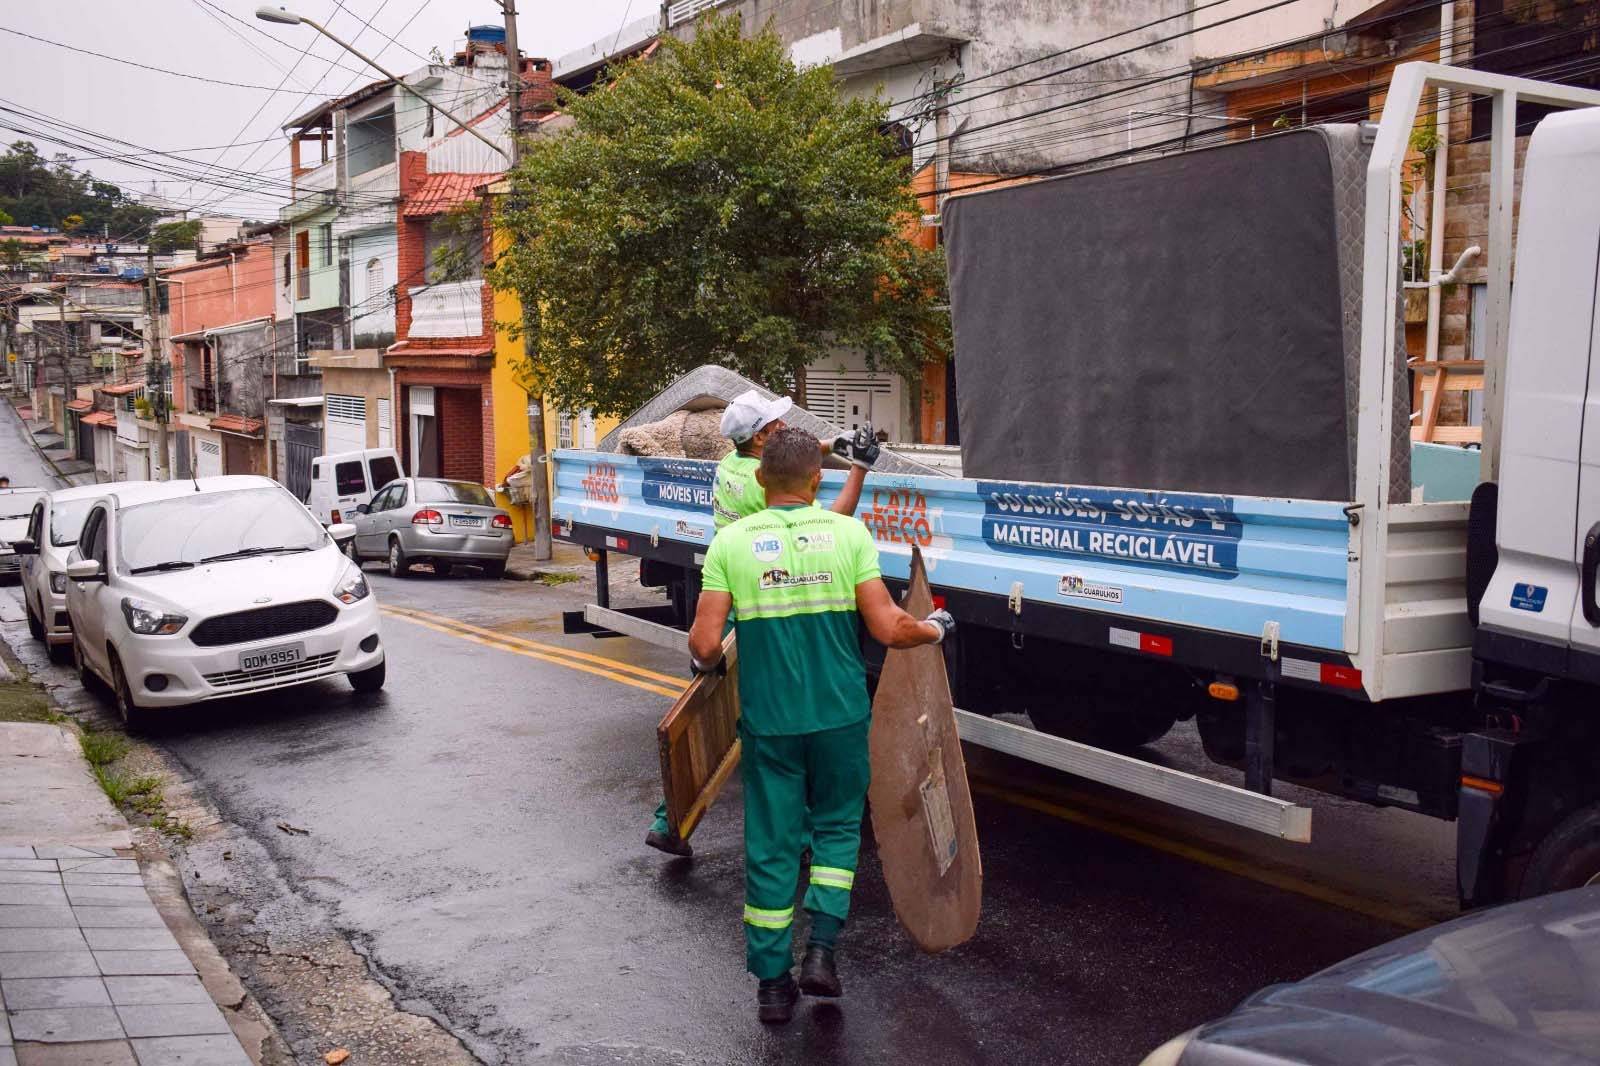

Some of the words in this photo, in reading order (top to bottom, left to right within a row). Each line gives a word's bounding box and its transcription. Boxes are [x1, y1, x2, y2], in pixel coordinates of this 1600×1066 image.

[581, 478, 619, 503] TRECO
[659, 482, 691, 503] MÓVEIS
[1112, 498, 1195, 528] SOFÁS
[861, 512, 933, 547] TRECO
[993, 523, 1085, 551] MATERIAL
[1089, 531, 1221, 567] RECICLÁVEL
[1083, 588, 1119, 599] GUARULHOS
